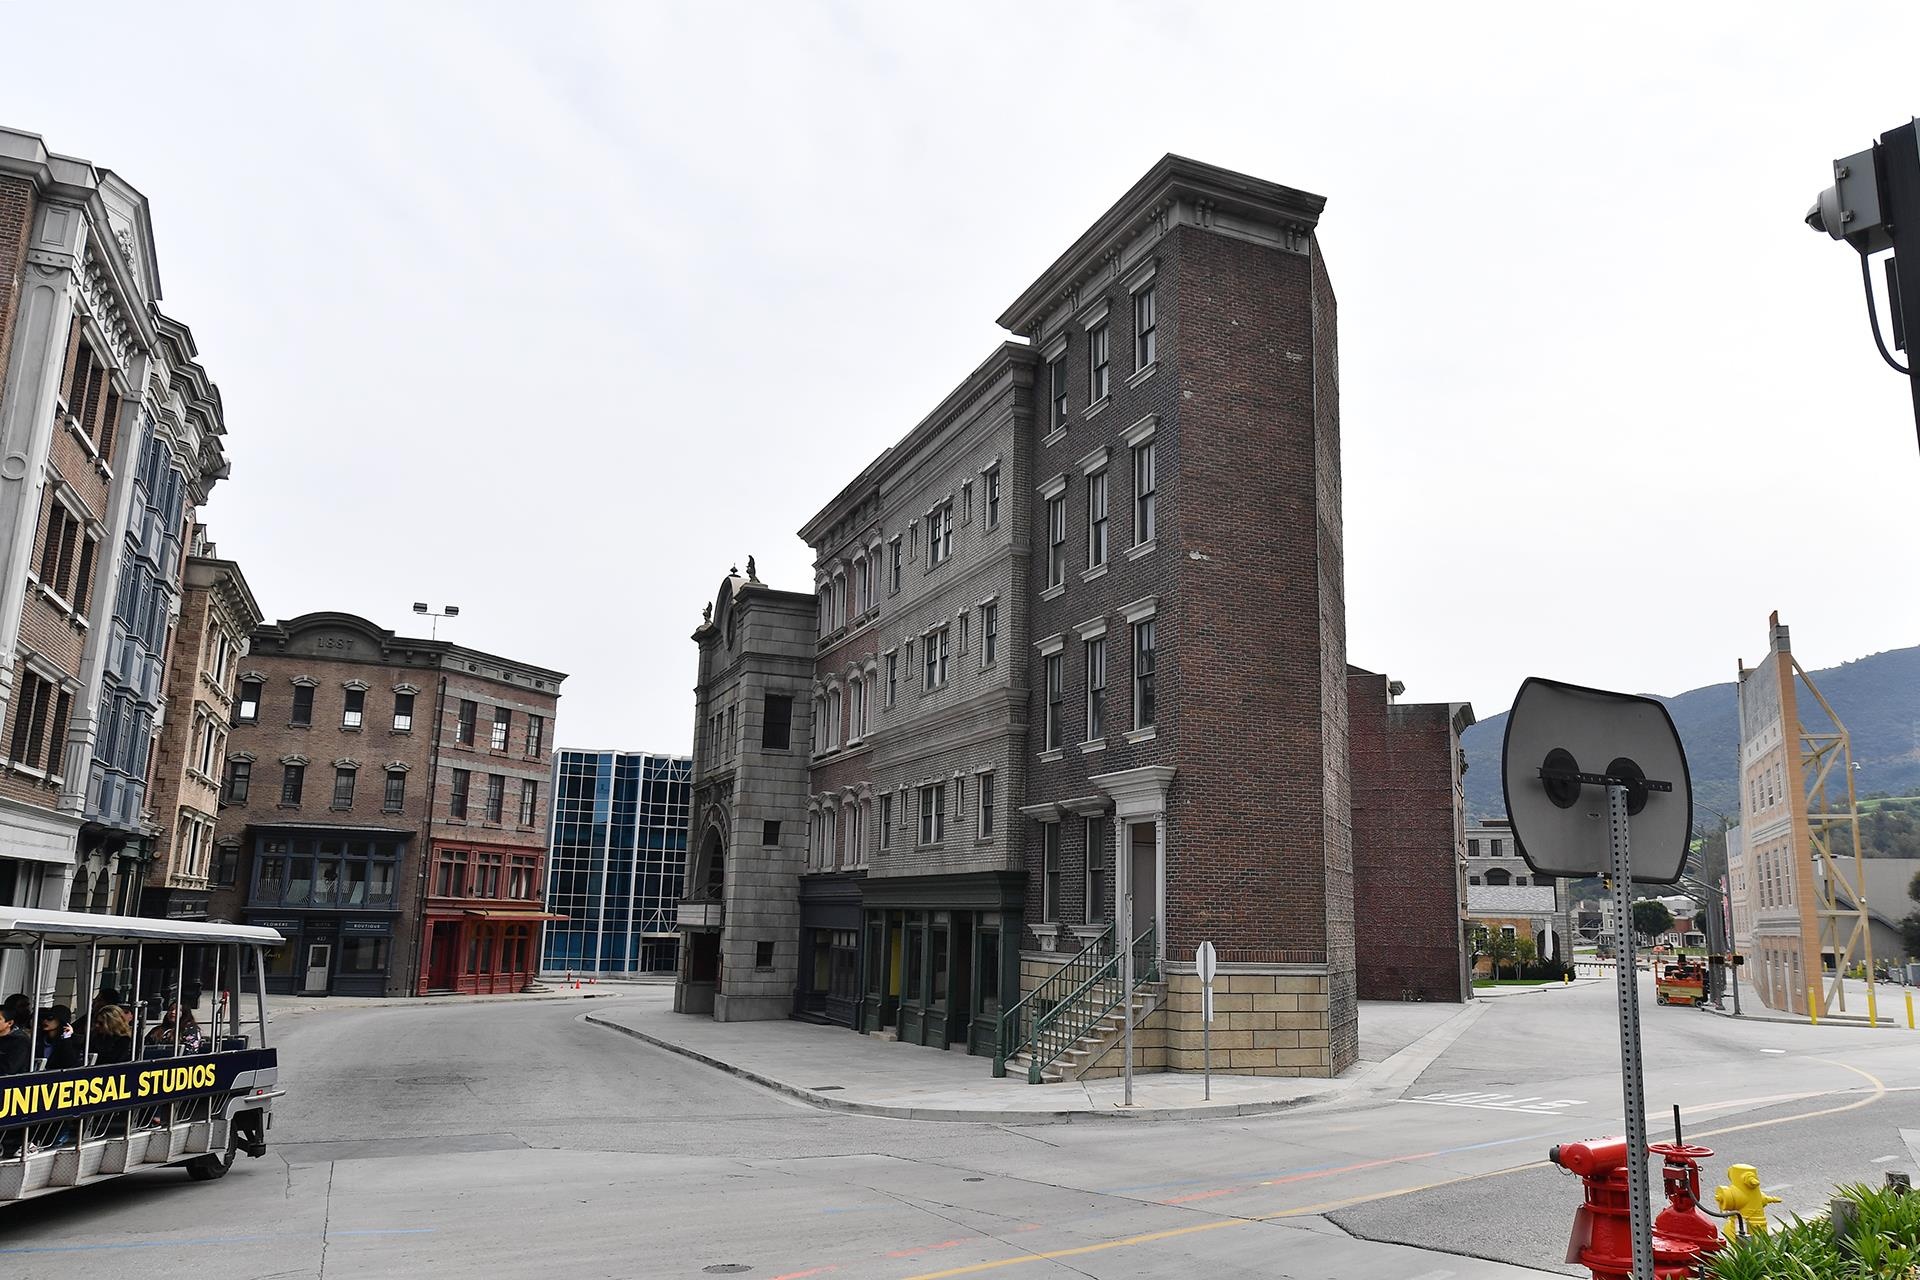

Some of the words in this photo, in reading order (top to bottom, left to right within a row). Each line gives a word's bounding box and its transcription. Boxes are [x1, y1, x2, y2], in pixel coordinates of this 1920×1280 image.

[318, 637, 353, 650] 1887
[0, 1074, 131, 1118] UNIVERSAL
[138, 1063, 216, 1097] STUDIOS
[1411, 1091, 1590, 1110] STOP
